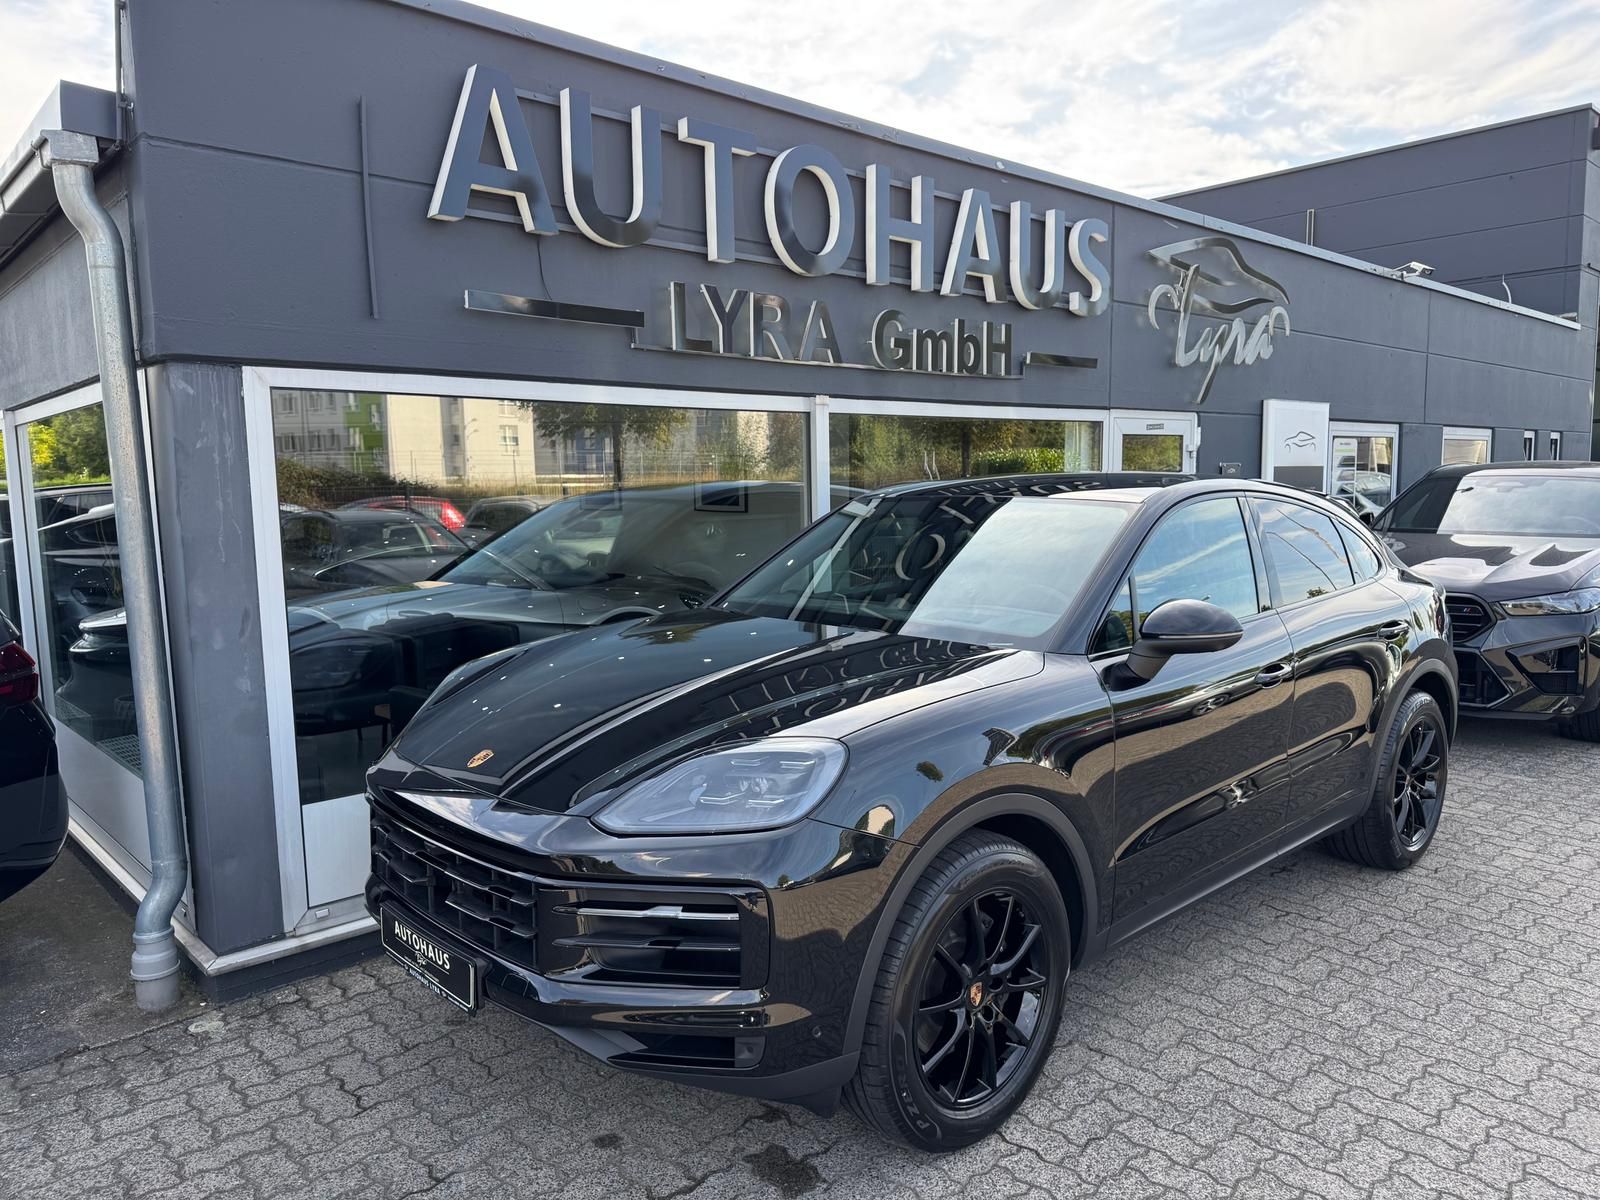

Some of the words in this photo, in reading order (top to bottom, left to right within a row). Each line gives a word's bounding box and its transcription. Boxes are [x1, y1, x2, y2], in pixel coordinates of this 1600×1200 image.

[427, 63, 1112, 318] AUTOHAUS
[669, 281, 842, 364] LYRA
[869, 308, 1012, 376] GmbH
[1175, 263, 1273, 405] Lyra
[394, 920, 451, 970] AUTOHAUS
